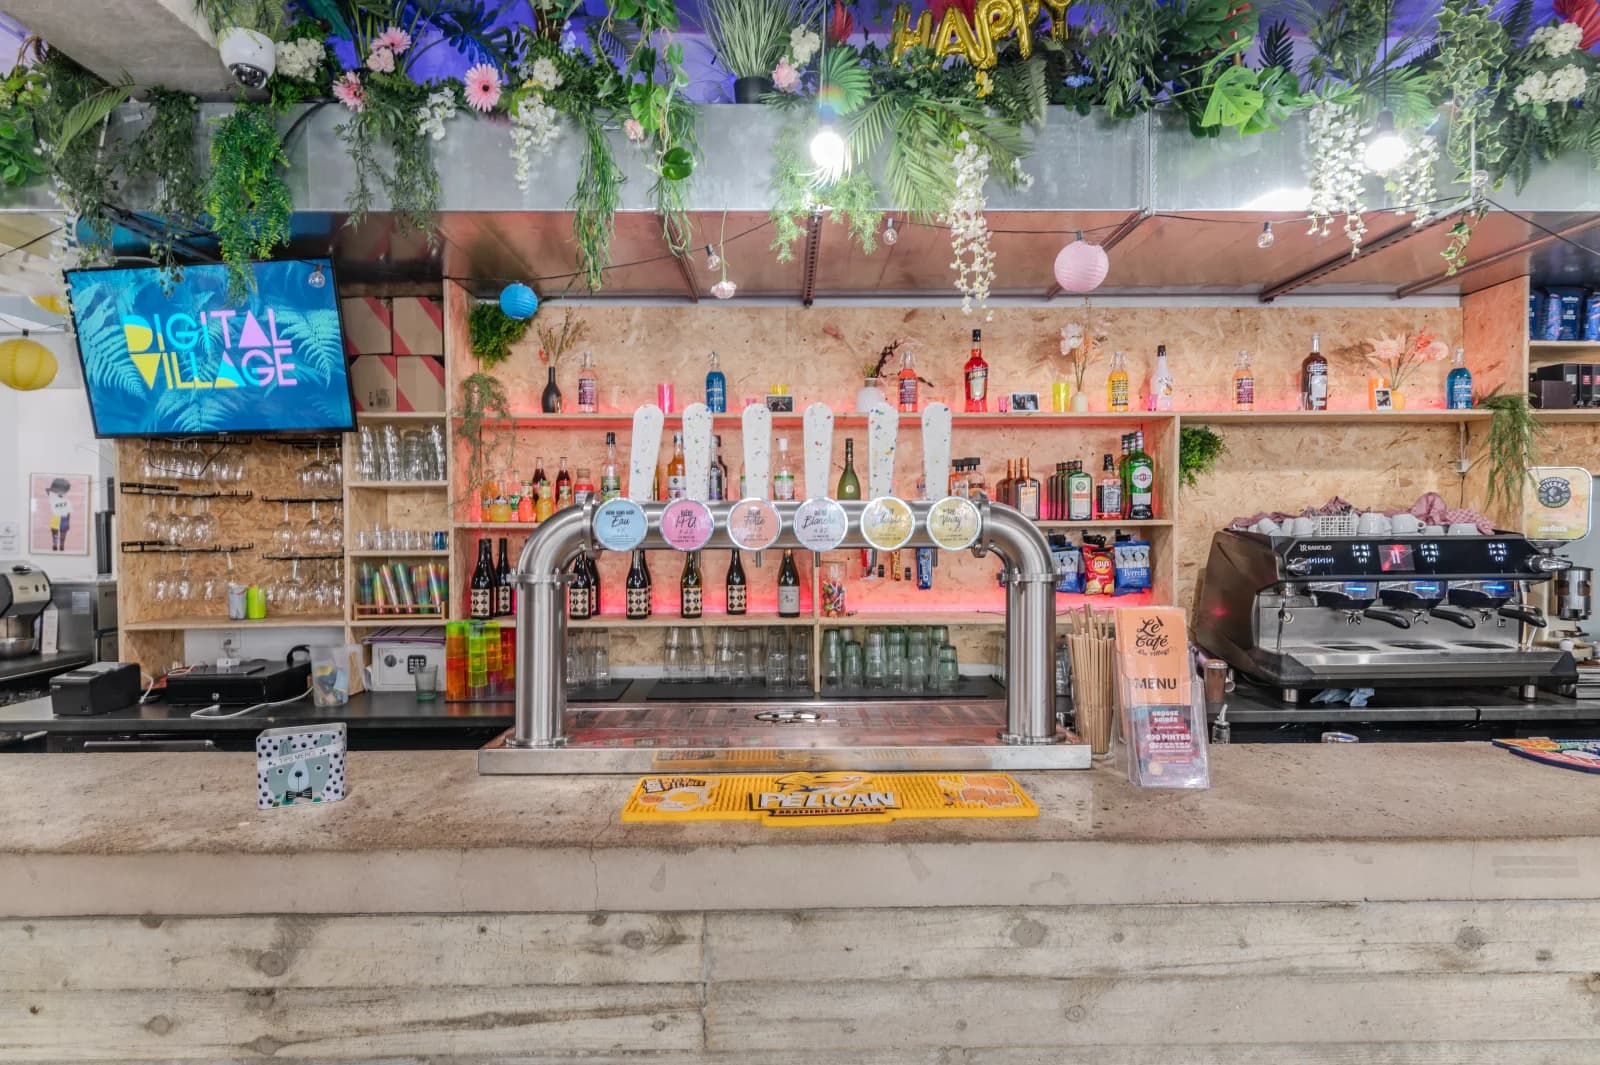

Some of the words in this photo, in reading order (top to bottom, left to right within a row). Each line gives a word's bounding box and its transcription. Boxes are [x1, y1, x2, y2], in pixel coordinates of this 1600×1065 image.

[891, 0, 1071, 69] HAPPY
[123, 308, 292, 352] DIGITAL
[129, 347, 298, 391] VILLAGE
[611, 515, 630, 528] Eau
[1137, 617, 1161, 637] Le
[1136, 634, 1169, 650] Café
[1134, 678, 1177, 690] MENU
